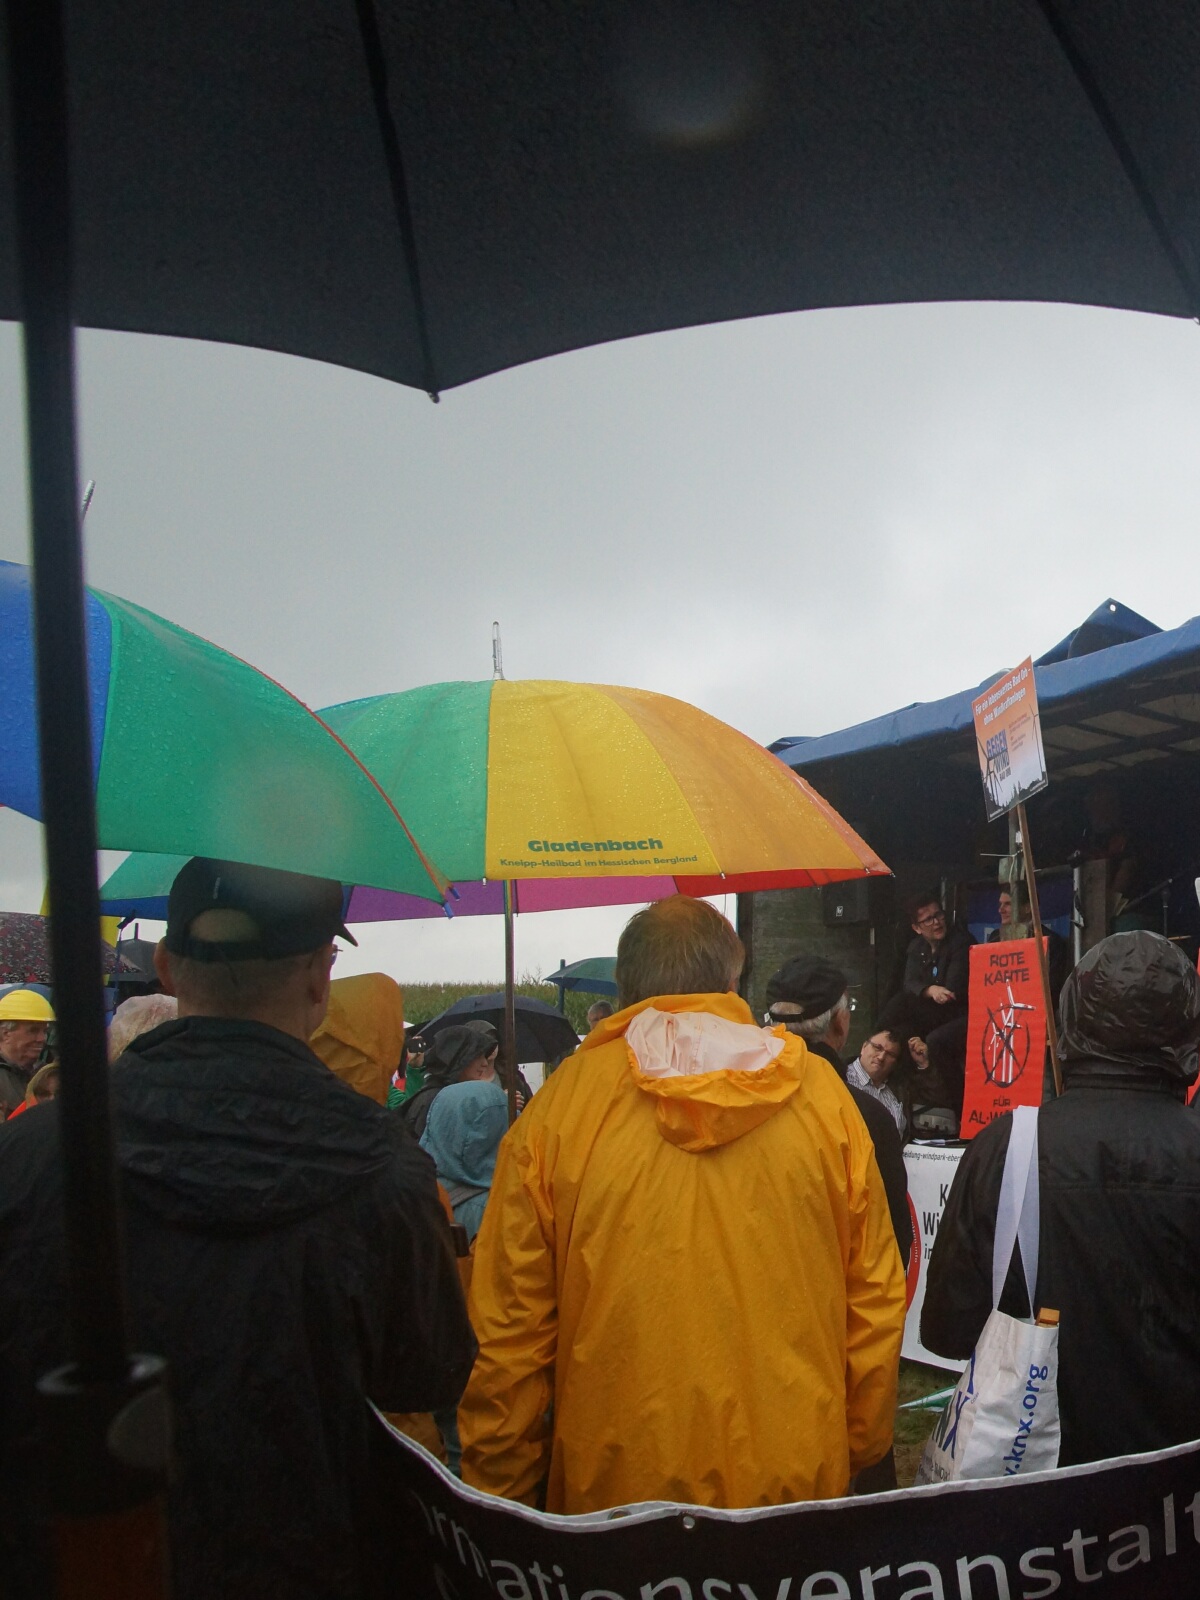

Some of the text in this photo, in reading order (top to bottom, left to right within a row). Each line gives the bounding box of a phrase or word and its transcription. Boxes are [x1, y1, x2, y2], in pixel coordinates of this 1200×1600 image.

[1012, 673, 1022, 688] Bad
[983, 712, 994, 726] ohne
[986, 728, 1008, 758] GEGEN
[528, 838, 663, 852] Gladenbach
[500, 858, 582, 868] Kneipp-Heilbad
[599, 858, 651, 866] Hessischen
[654, 854, 698, 866] Bergland
[990, 950, 1025, 966] ROTE
[984, 968, 1030, 987] KARTE
[993, 1098, 1011, 1107] FÜR
